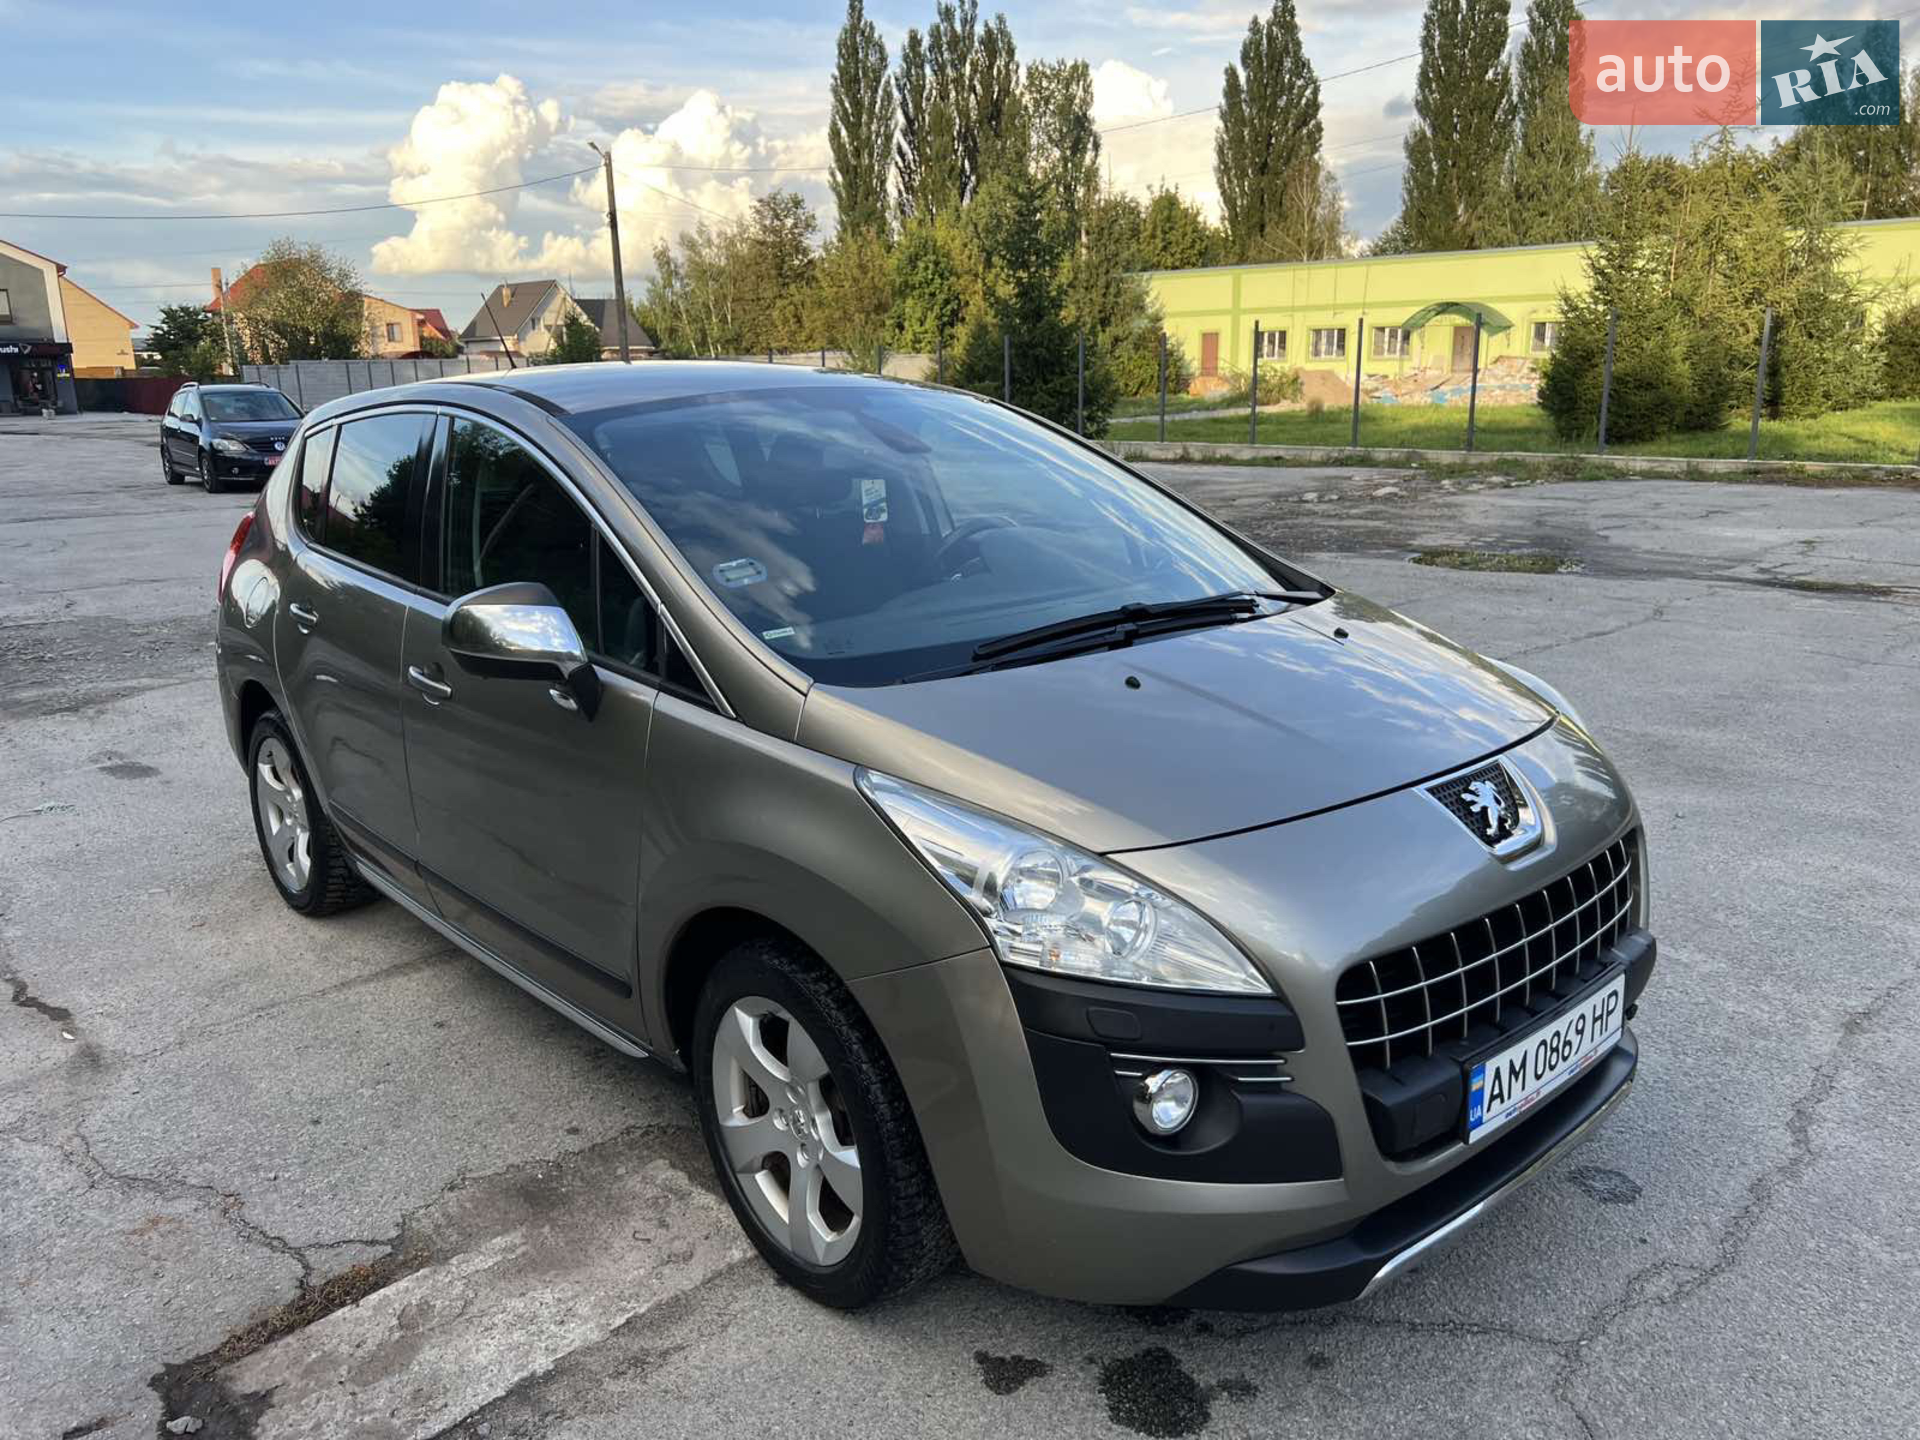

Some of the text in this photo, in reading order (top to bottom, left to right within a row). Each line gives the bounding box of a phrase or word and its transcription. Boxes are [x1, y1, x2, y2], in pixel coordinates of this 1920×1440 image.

[1486, 1049, 1527, 1113] AM
[1533, 1013, 1586, 1081] 0869
[1590, 989, 1619, 1043] HP
[1470, 1105, 1482, 1121] UA
